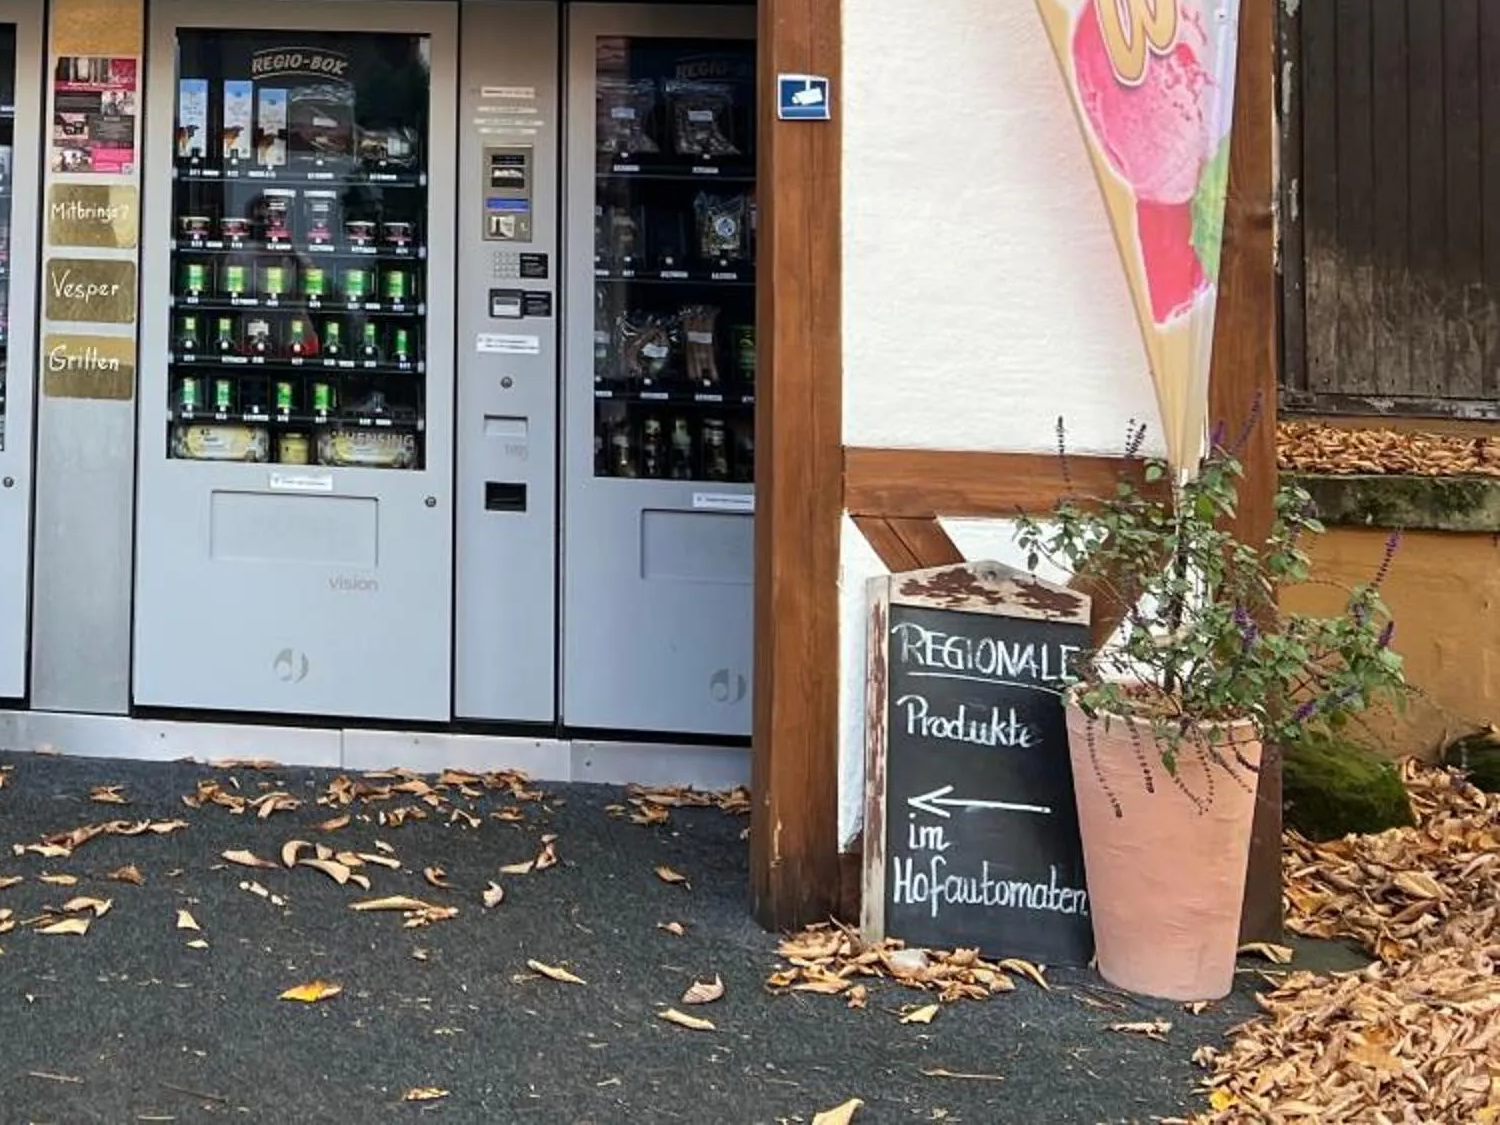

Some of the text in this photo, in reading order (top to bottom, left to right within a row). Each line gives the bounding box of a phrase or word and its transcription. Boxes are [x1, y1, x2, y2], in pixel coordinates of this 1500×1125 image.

[251, 54, 349, 75] REGIO-BOX
[51, 268, 119, 304] Vesper
[890, 621, 1082, 683] REGIONALE
[896, 694, 1036, 749] Produkte
[908, 812, 952, 852] im
